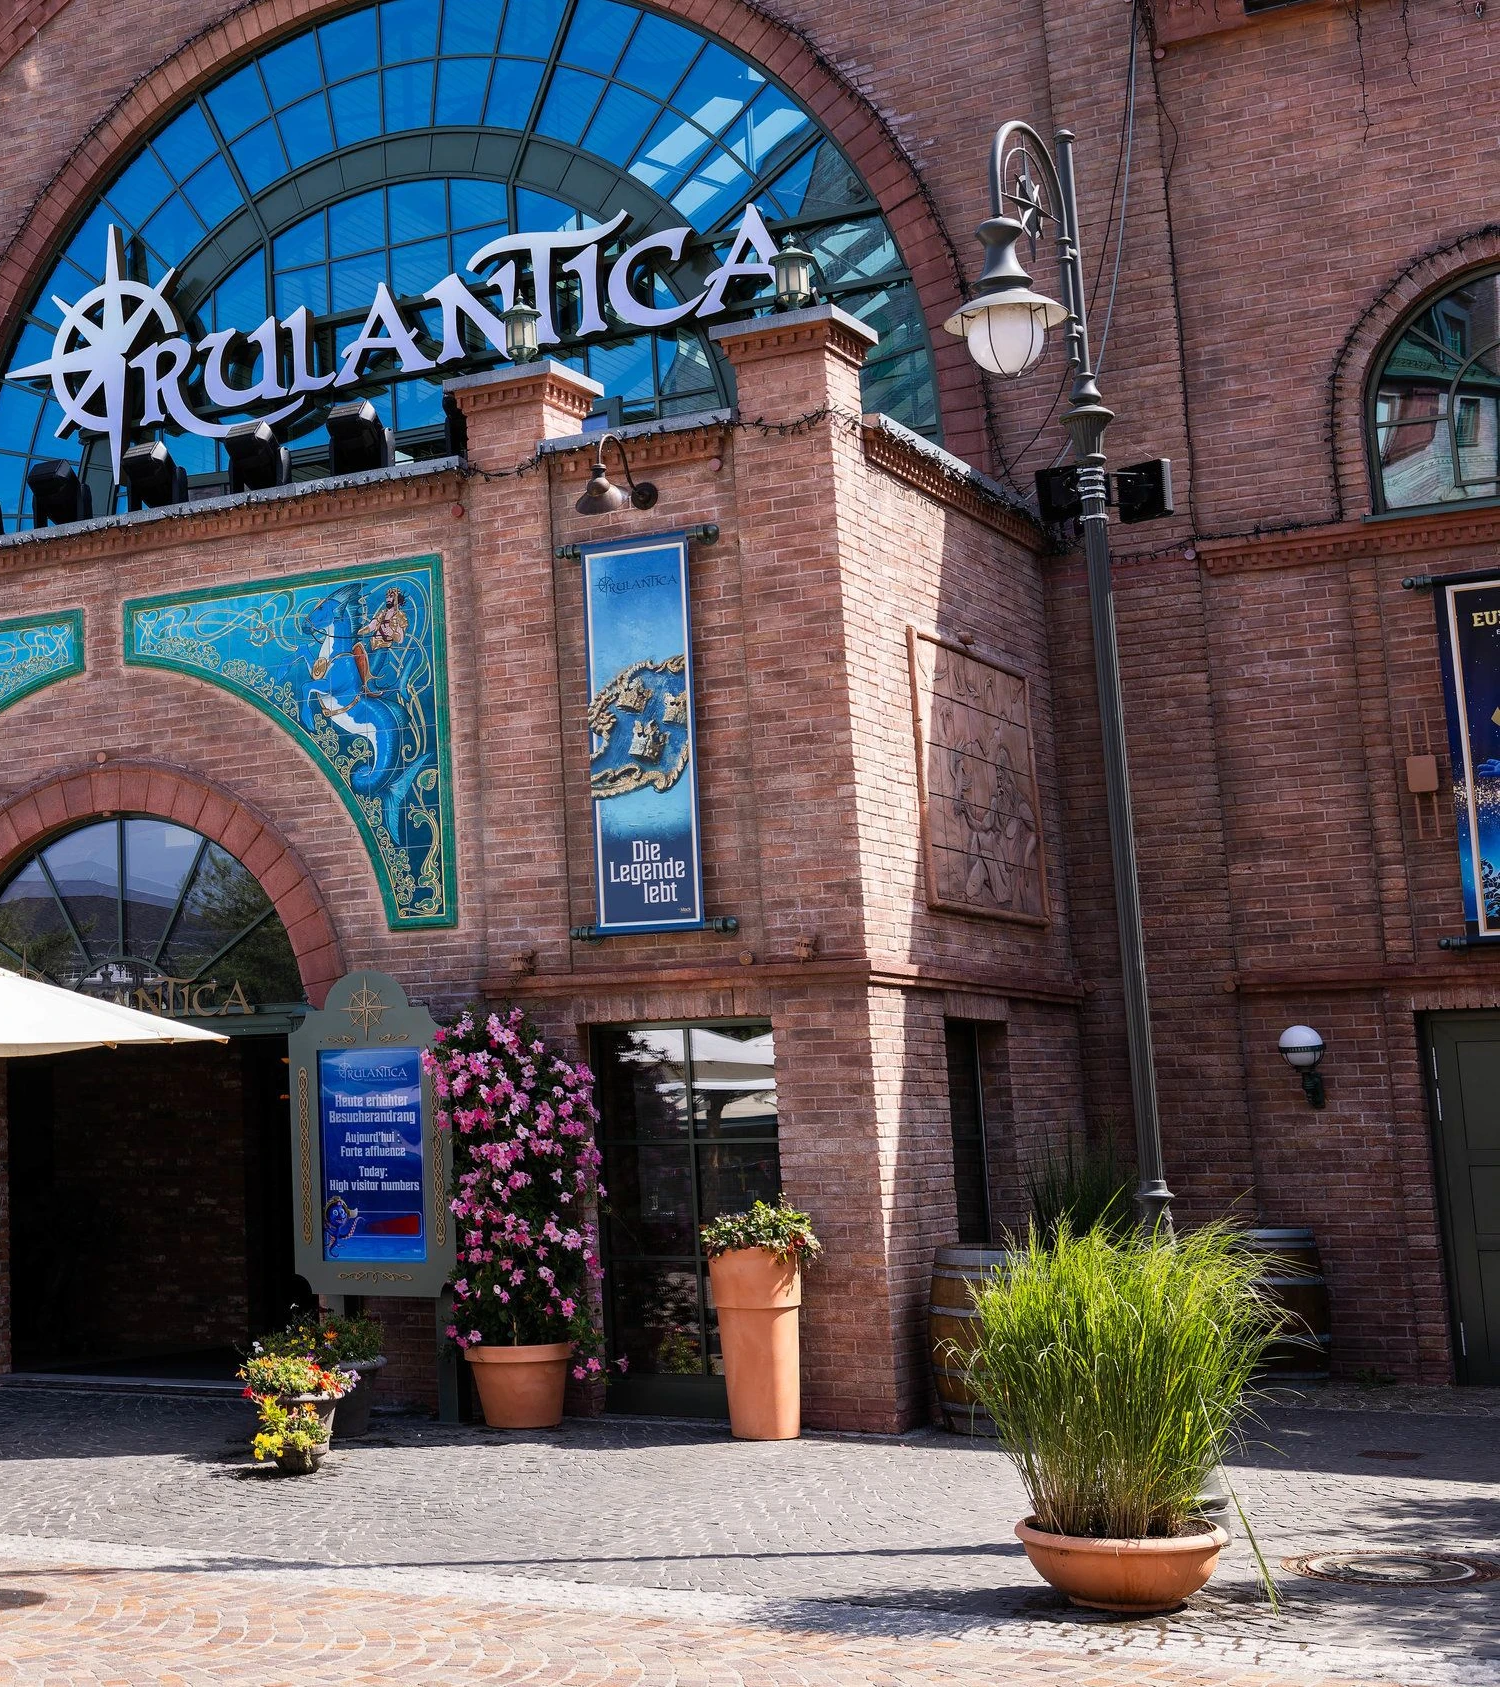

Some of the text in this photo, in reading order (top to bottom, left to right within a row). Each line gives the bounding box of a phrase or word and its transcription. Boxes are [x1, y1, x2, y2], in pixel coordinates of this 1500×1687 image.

[128, 203, 780, 438] RULANTICA
[607, 574, 679, 595] RULANTICA
[632, 840, 661, 862] Die
[609, 857, 686, 886] Legende
[643, 881, 678, 904] lebt
[346, 1065, 408, 1081] RULANTICA
[334, 1093, 409, 1108] Heute erhöhter
[328, 1109, 416, 1125] Besucherandrang
[345, 1131, 395, 1145] Aujourd'hui
[340, 1145, 406, 1157] Forte affluence
[358, 1165, 388, 1179] Today:
[329, 1179, 420, 1193] High visitor numbers
